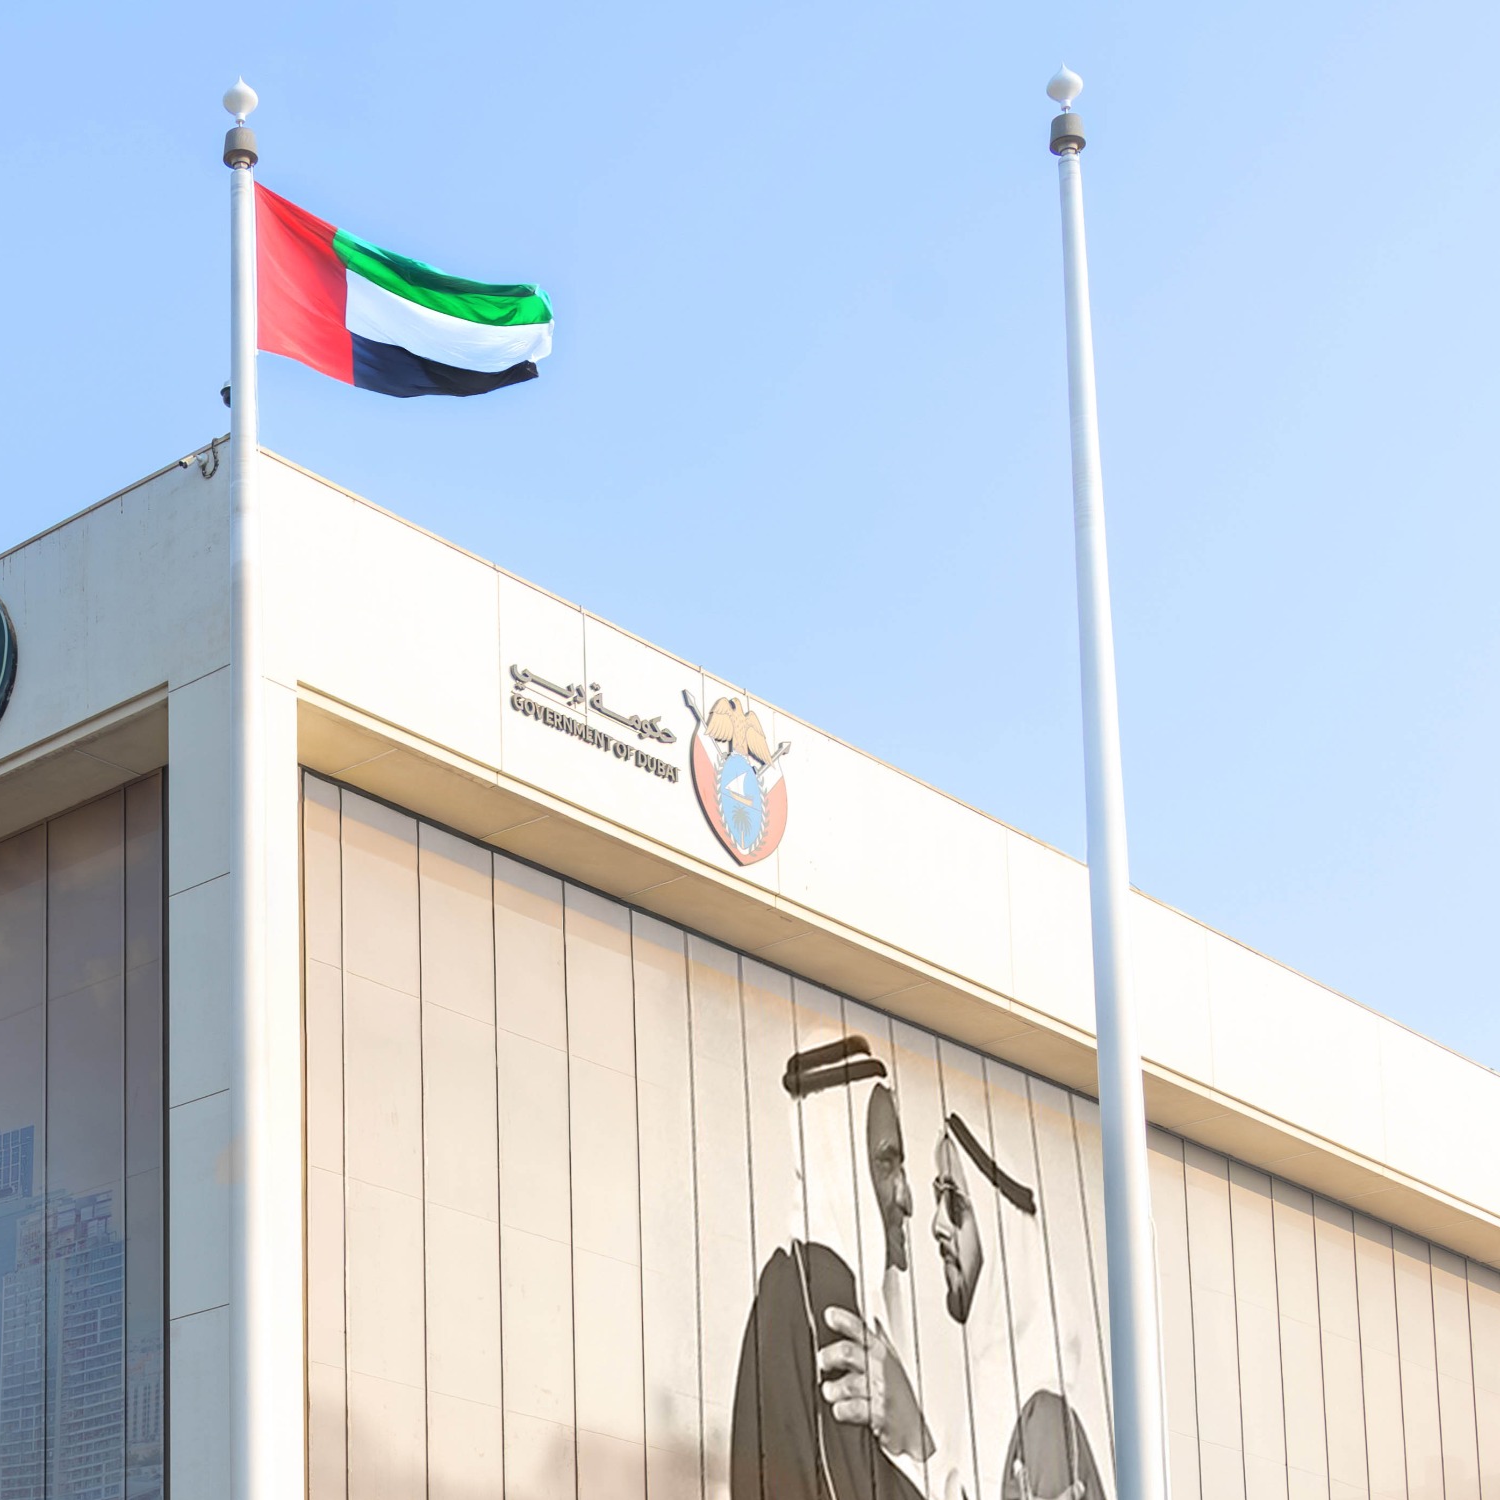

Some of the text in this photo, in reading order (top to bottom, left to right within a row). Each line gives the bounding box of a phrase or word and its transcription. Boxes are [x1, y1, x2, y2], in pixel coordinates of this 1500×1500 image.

[510, 664, 677, 743] حكومة دبي
[510, 692, 680, 783] GOVERNMENT OF DUBAI
